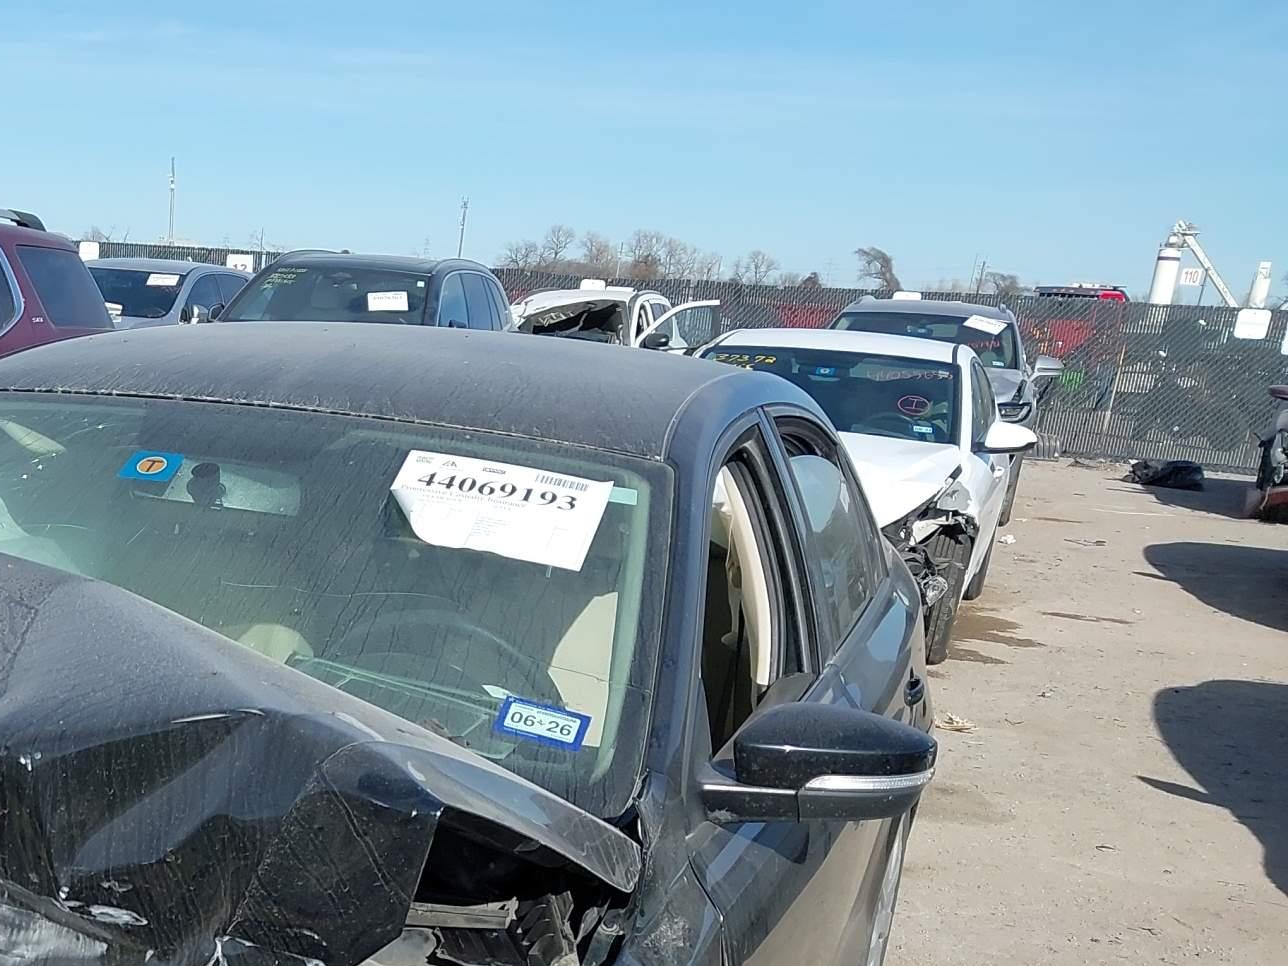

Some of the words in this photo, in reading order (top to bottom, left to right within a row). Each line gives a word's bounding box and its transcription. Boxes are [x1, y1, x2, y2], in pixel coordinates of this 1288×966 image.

[1184, 270, 1199, 284] 110
[417, 471, 578, 512] 44069193
[510, 711, 537, 727] 06
[545, 720, 573, 736] 26
